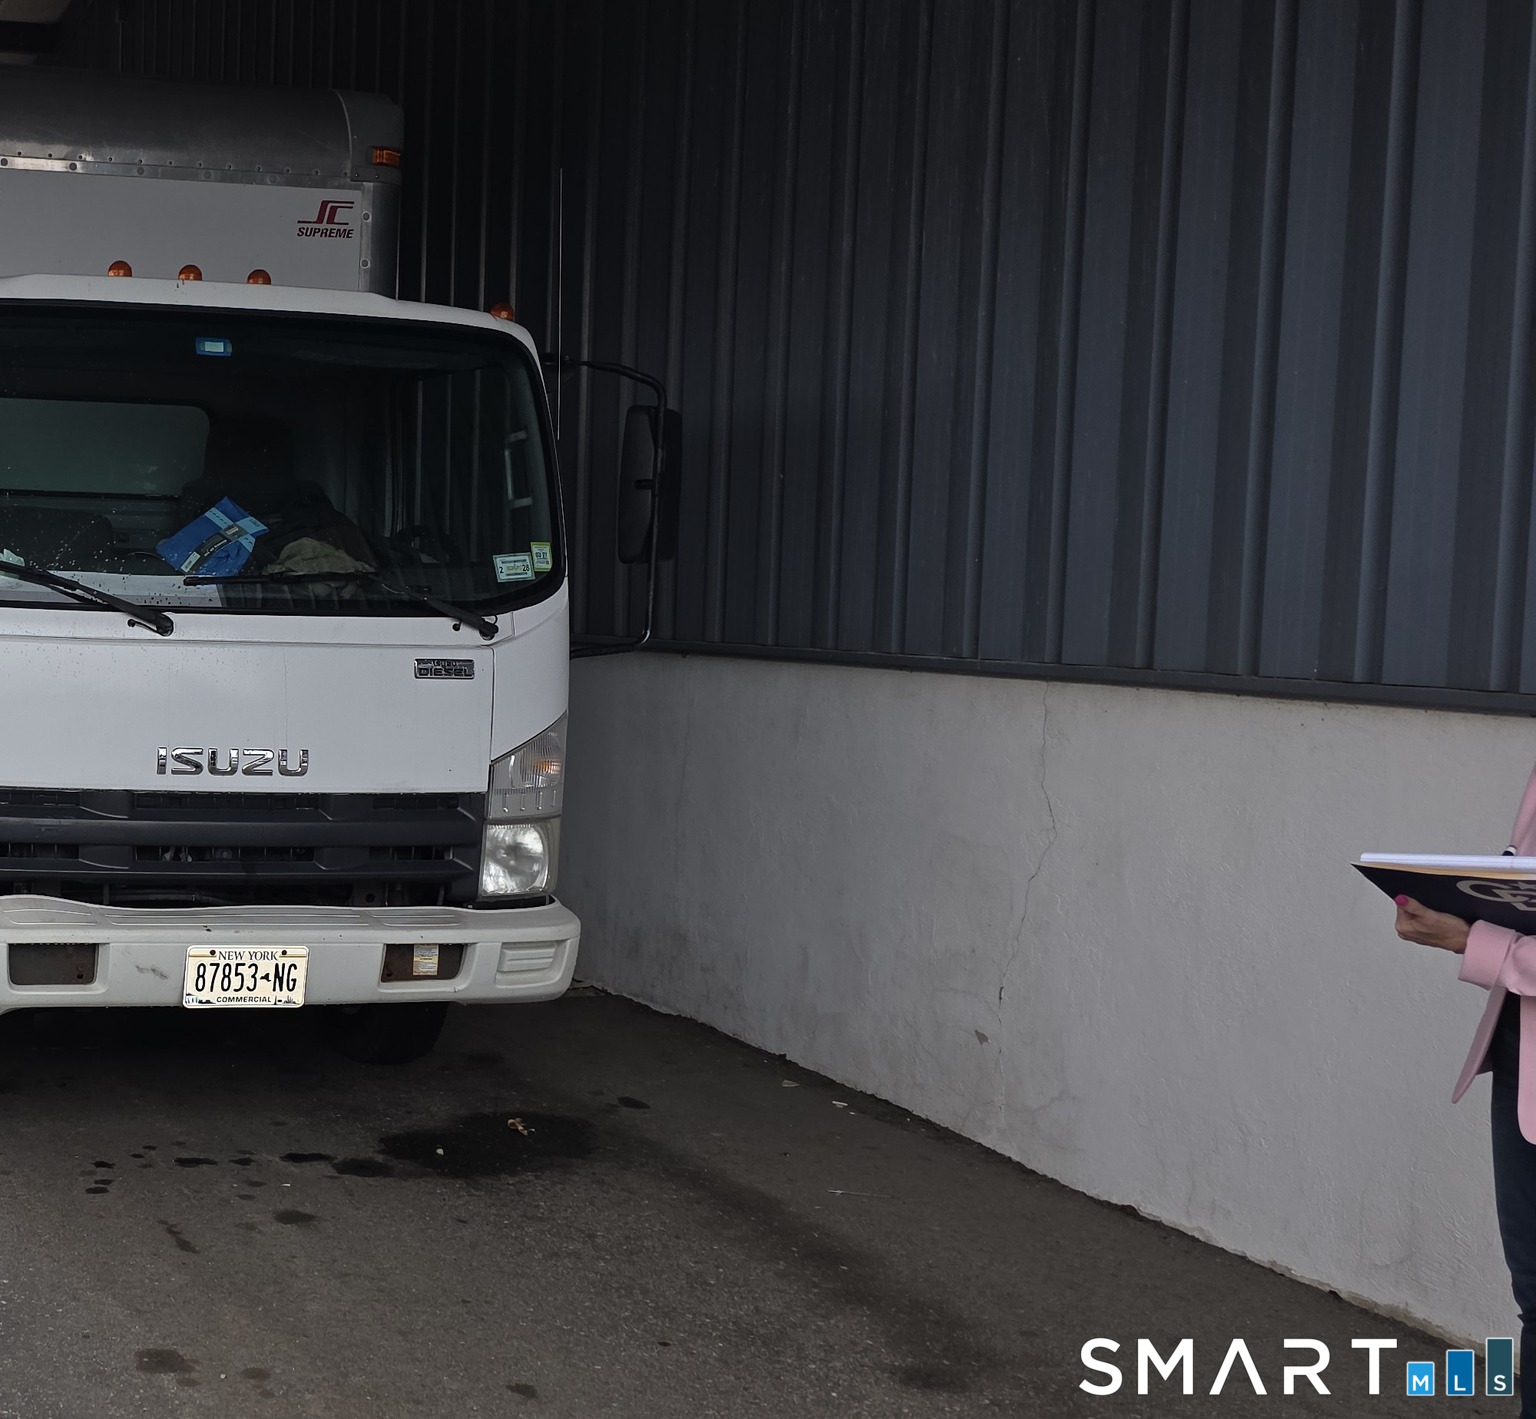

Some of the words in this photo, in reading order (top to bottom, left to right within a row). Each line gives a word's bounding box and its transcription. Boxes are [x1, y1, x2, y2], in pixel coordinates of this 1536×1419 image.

[296, 226, 354, 239] SUPREME
[419, 667, 474, 677] DIESEL
[156, 746, 309, 776] ISUZU
[218, 951, 245, 961] NEW
[248, 950, 279, 961] YORK
[195, 962, 259, 993] 87853
[272, 962, 298, 993] NG
